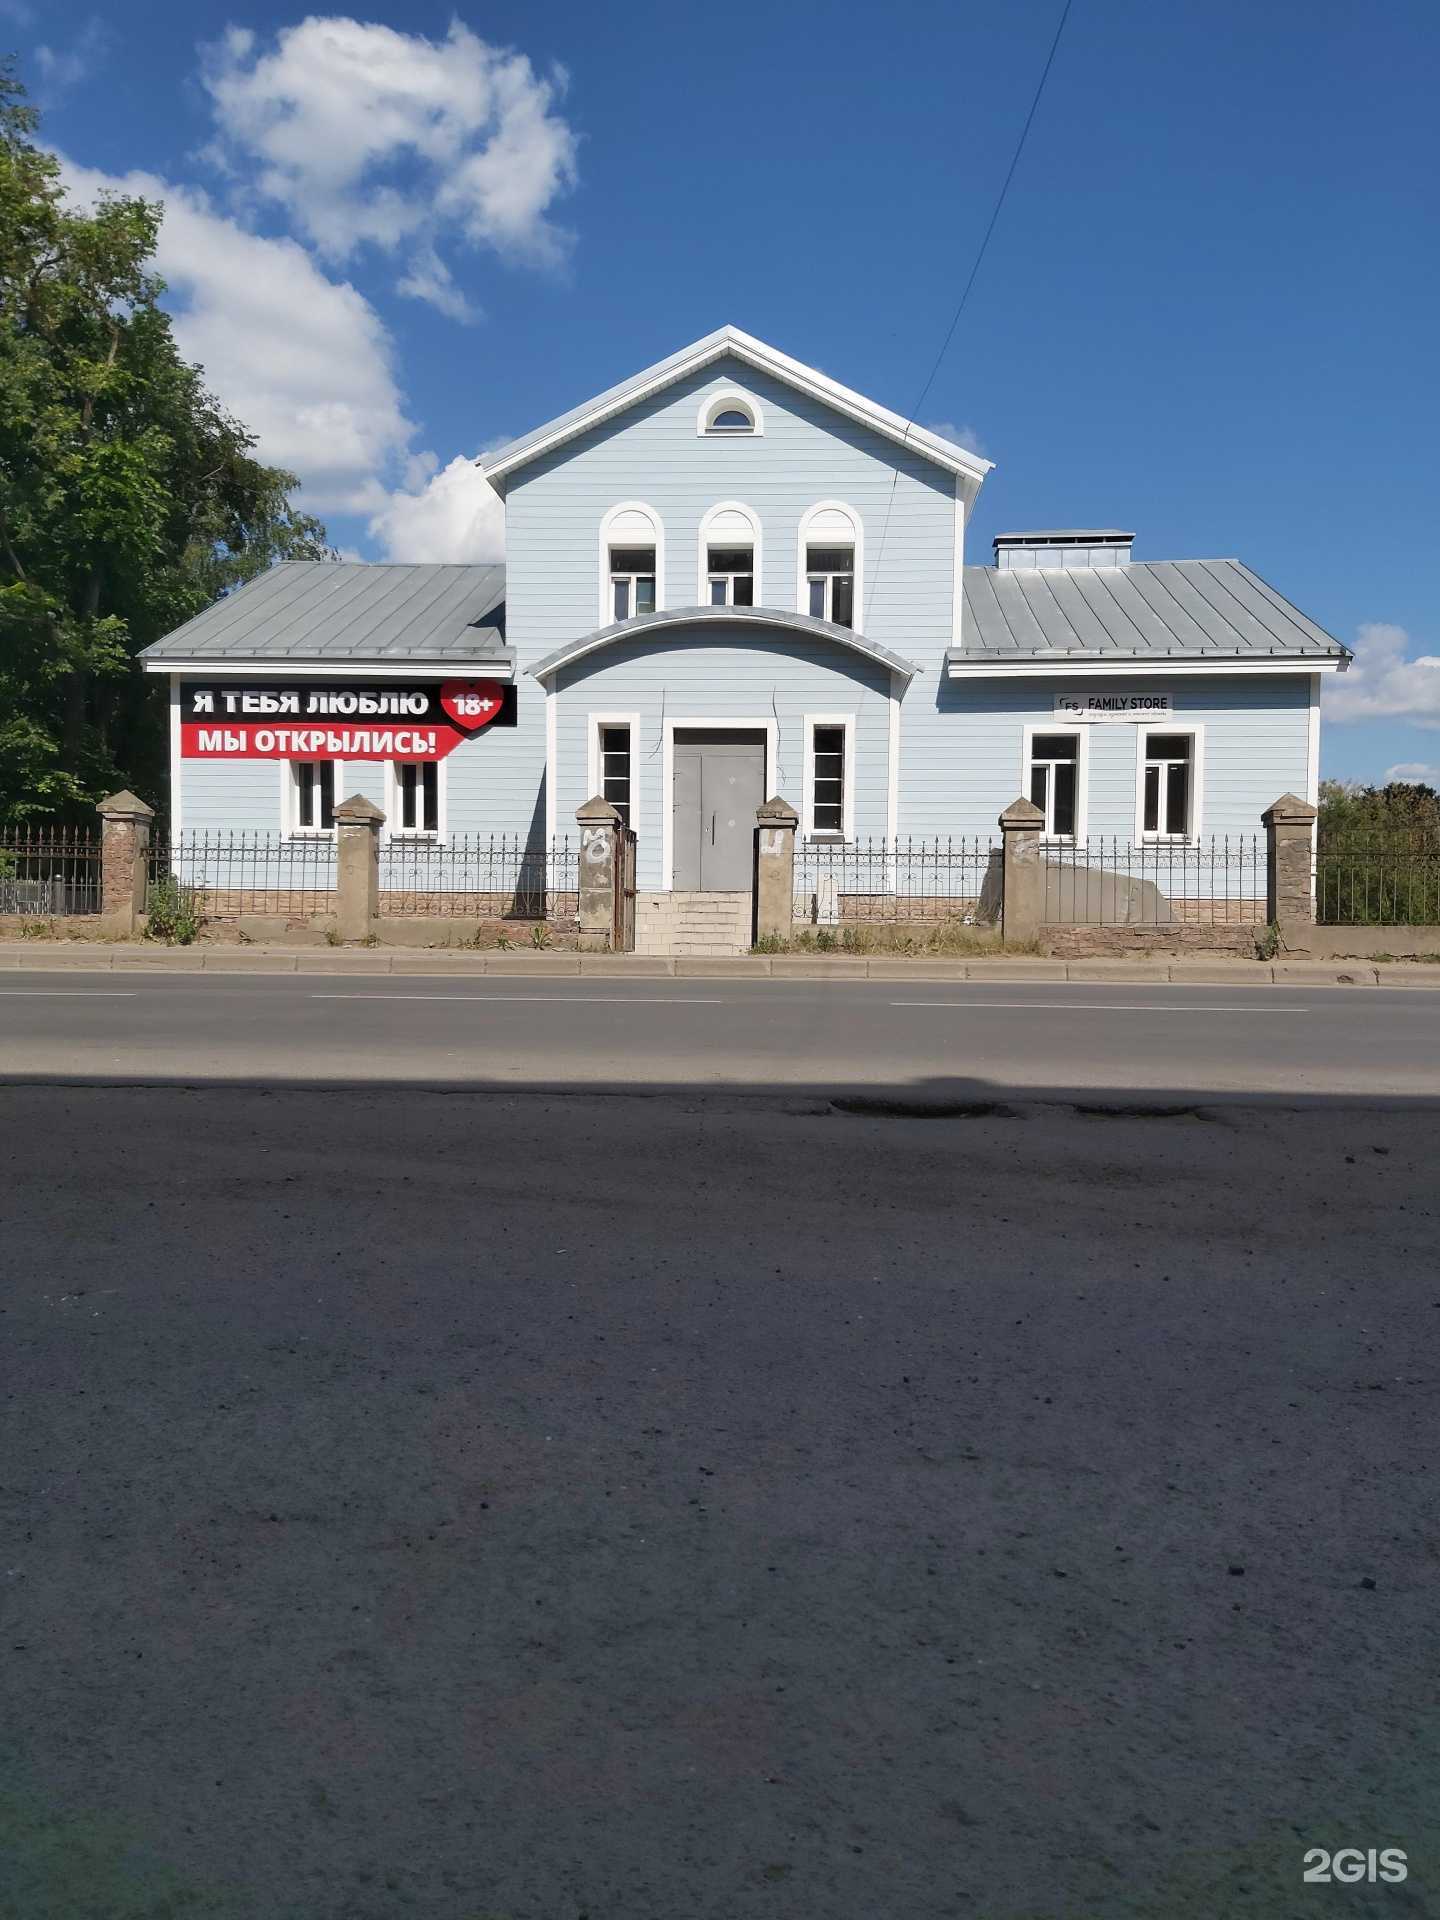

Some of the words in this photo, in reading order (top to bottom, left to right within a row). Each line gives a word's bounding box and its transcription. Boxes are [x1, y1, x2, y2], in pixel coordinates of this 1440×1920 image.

[193, 691, 214, 713] Я
[221, 691, 300, 714] ТЕБЯ
[307, 692, 429, 715] ЛЮБЛЮ
[452, 693, 494, 716] 18+
[1088, 697, 1127, 710] FAMILY
[1131, 697, 1168, 710] STORE
[199, 730, 246, 752] МЫ
[256, 731, 437, 754] ОТКРЫЛИСЬ!
